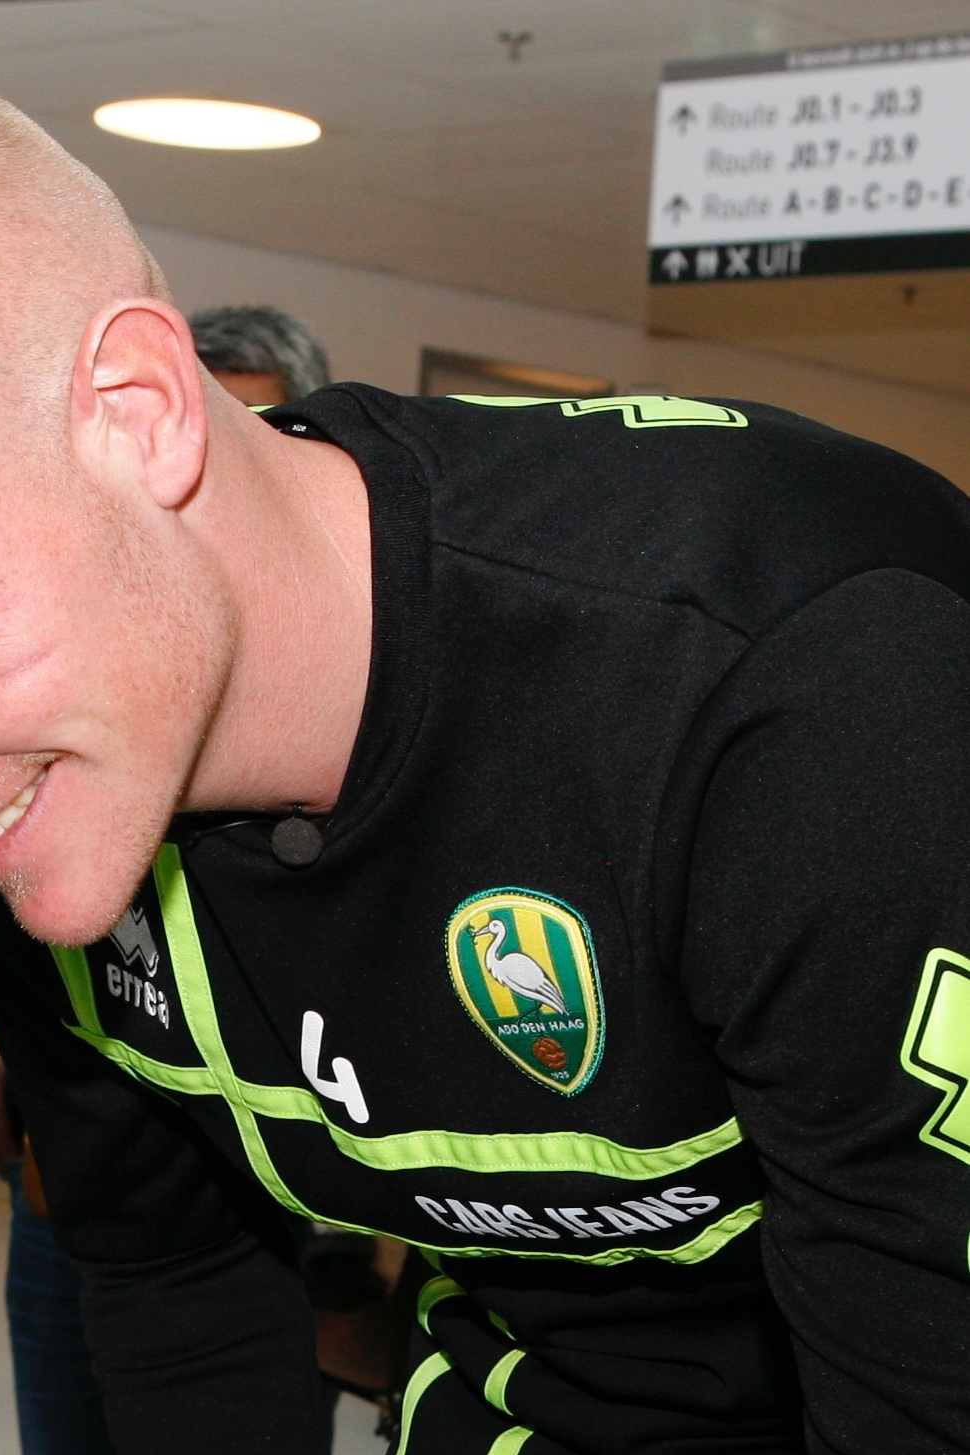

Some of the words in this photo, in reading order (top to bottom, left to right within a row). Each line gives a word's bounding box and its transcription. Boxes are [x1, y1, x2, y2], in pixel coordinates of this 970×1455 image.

[707, 101, 778, 130] Route
[704, 146, 776, 175] Route
[701, 191, 772, 220] Route
[757, 240, 806, 277] UIT
[498, 1023, 520, 1036] ADO
[520, 1021, 547, 1034] DEN
[548, 1018, 585, 1032] HAAG
[300, 1010, 370, 1124] 4
[414, 1195, 561, 1239] CARS
[543, 1186, 721, 1238] JEANS
